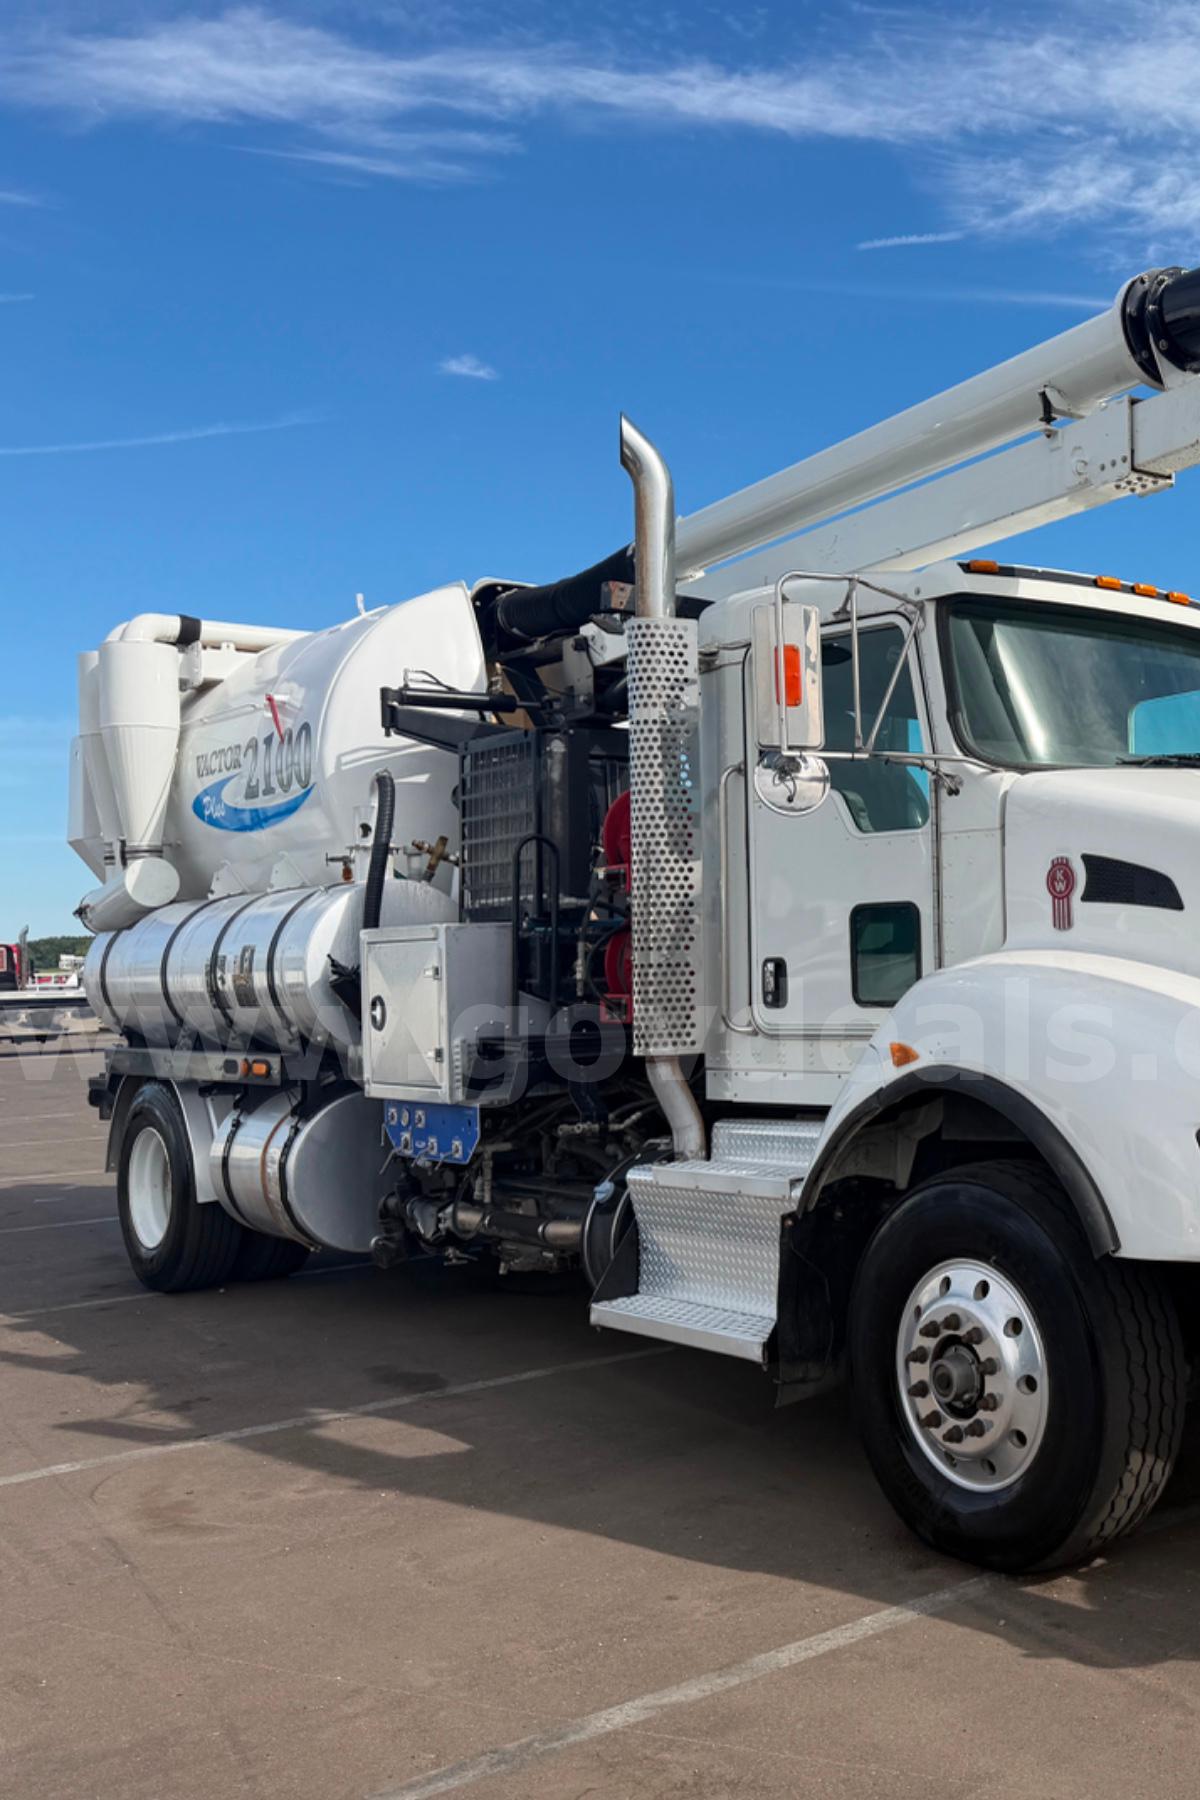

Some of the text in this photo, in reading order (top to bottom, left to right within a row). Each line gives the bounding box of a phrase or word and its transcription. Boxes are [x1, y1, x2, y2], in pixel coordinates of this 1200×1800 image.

[196, 721, 312, 800] VACTOR 2100
[203, 796, 225, 821] Plus
